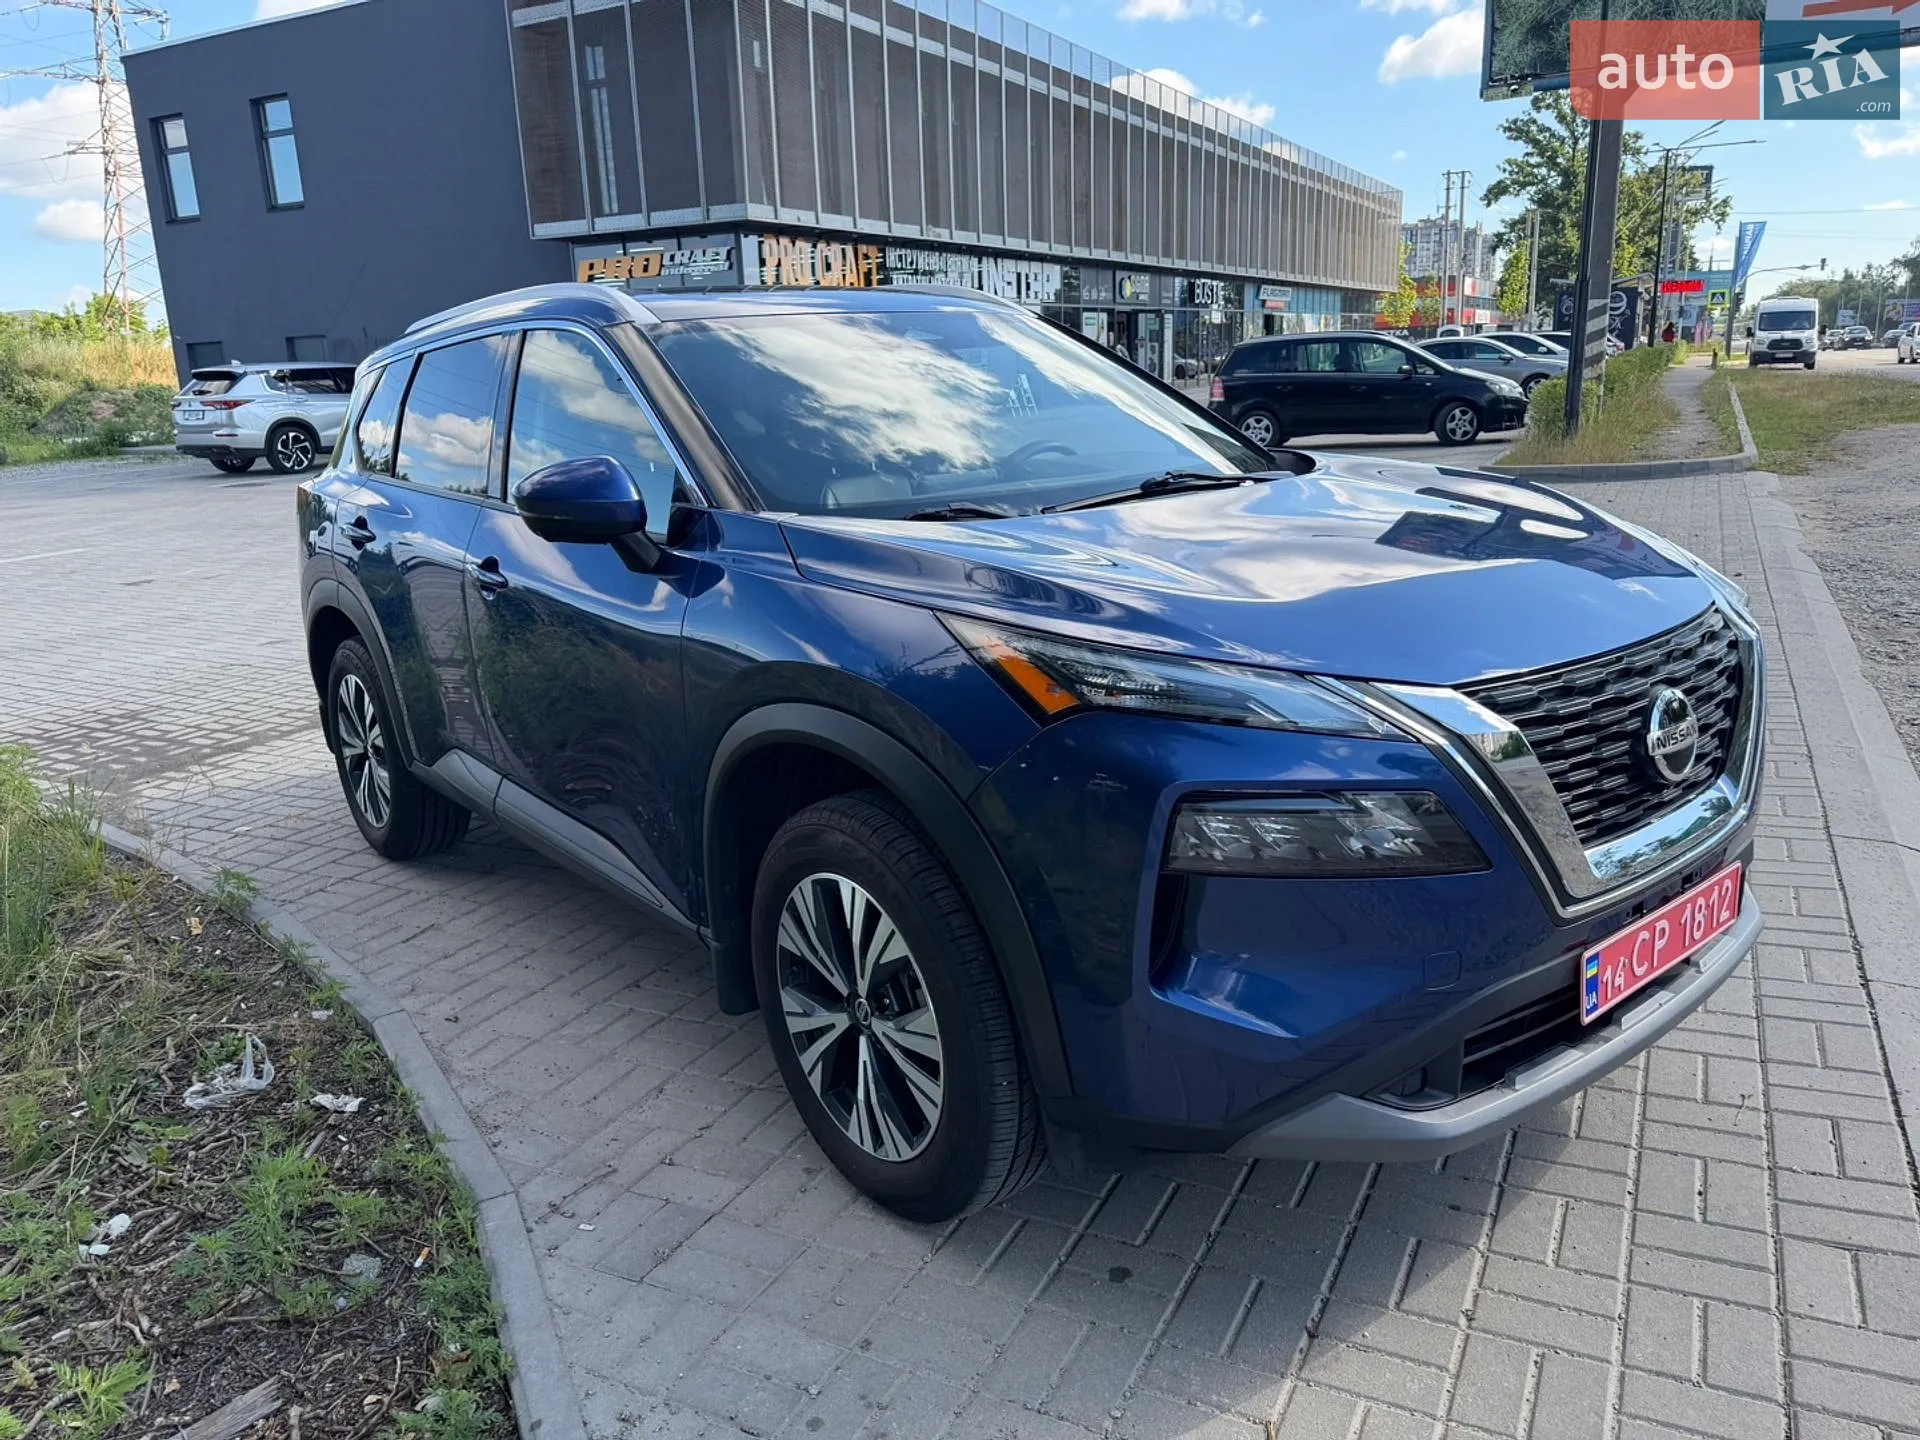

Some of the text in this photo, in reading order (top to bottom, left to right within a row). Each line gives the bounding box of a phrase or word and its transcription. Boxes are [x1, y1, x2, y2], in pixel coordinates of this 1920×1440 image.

[577, 246, 732, 283] PRO CRAFT
[1656, 724, 1697, 749] NISSAN
[1602, 879, 1732, 1000] 14 CP 1812
[1585, 991, 1598, 1010] UA
